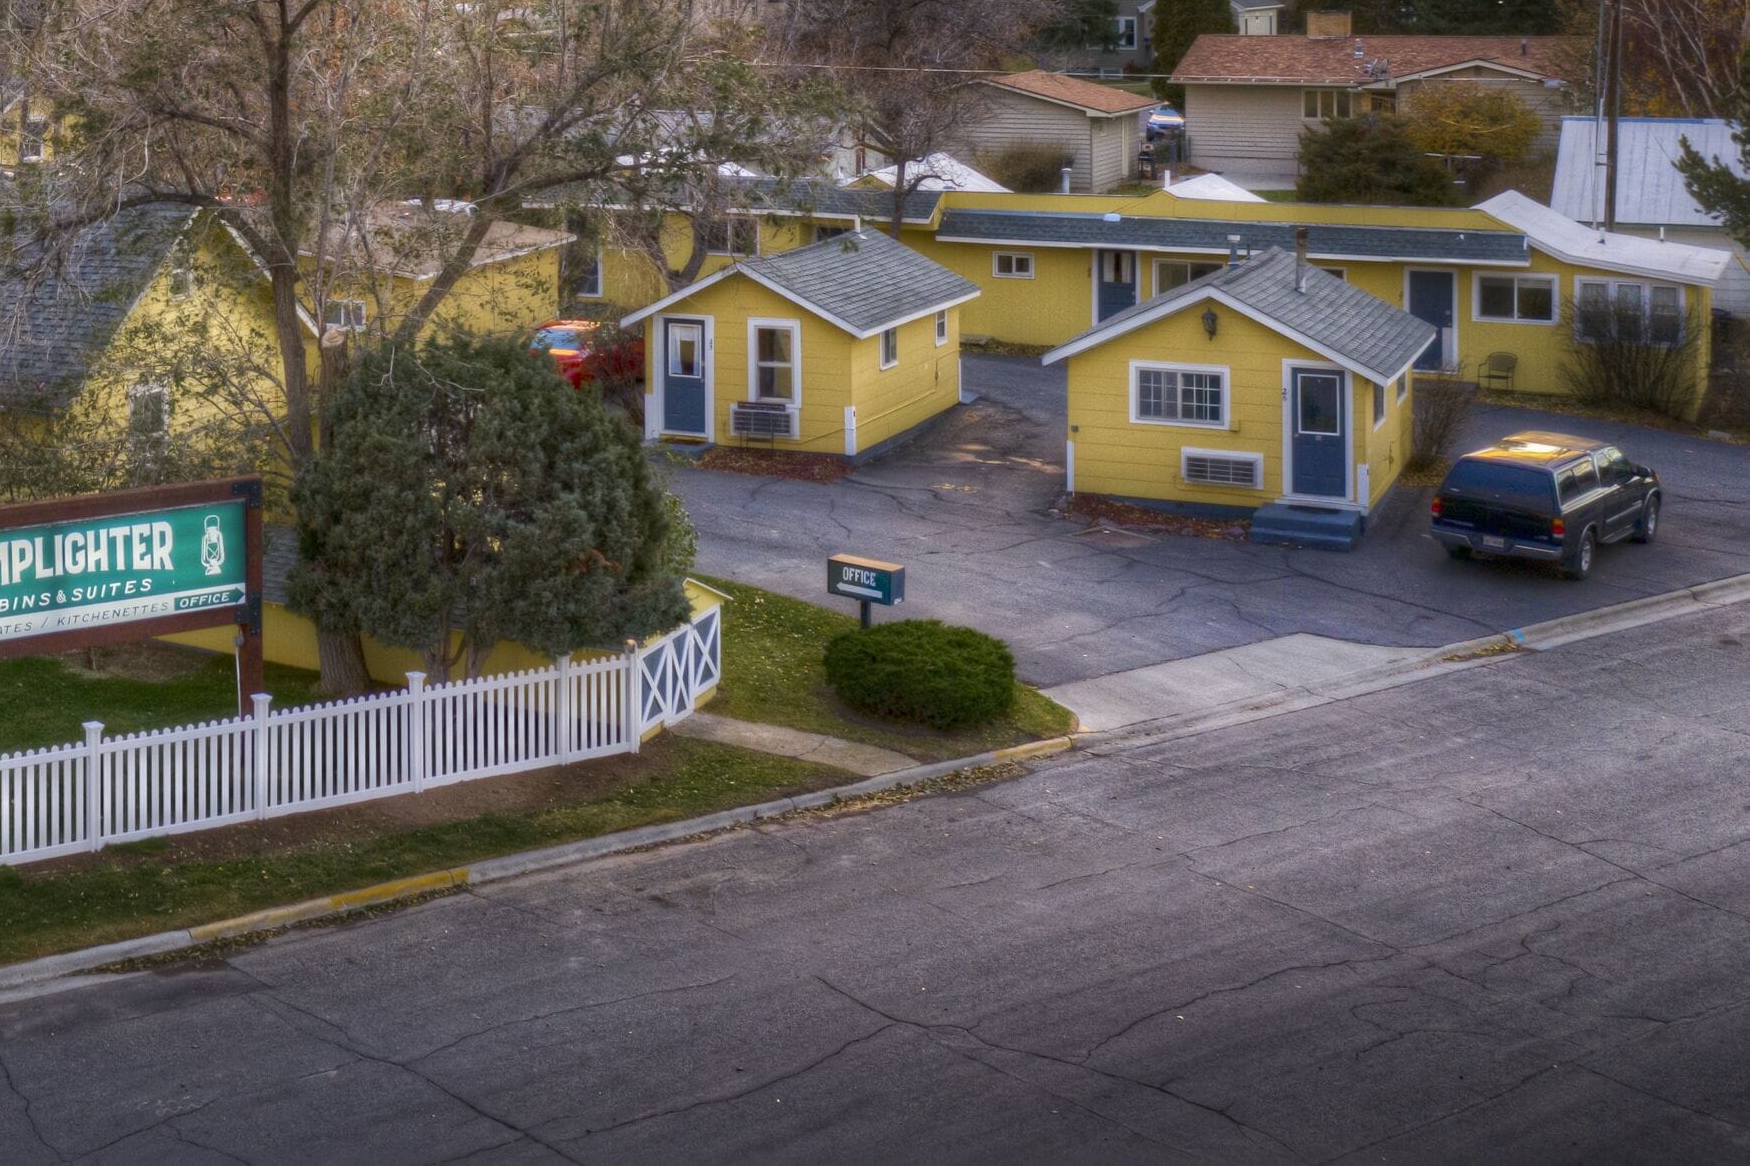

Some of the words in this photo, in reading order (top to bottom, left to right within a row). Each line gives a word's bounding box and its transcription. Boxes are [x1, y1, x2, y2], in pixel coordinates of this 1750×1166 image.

[842, 566, 877, 587] OFFICE
[56, 589, 67, 604] &
[71, 578, 153, 602] SUITES
[179, 591, 230, 609] OFFICE
[57, 601, 169, 627] KITCHENETTES
